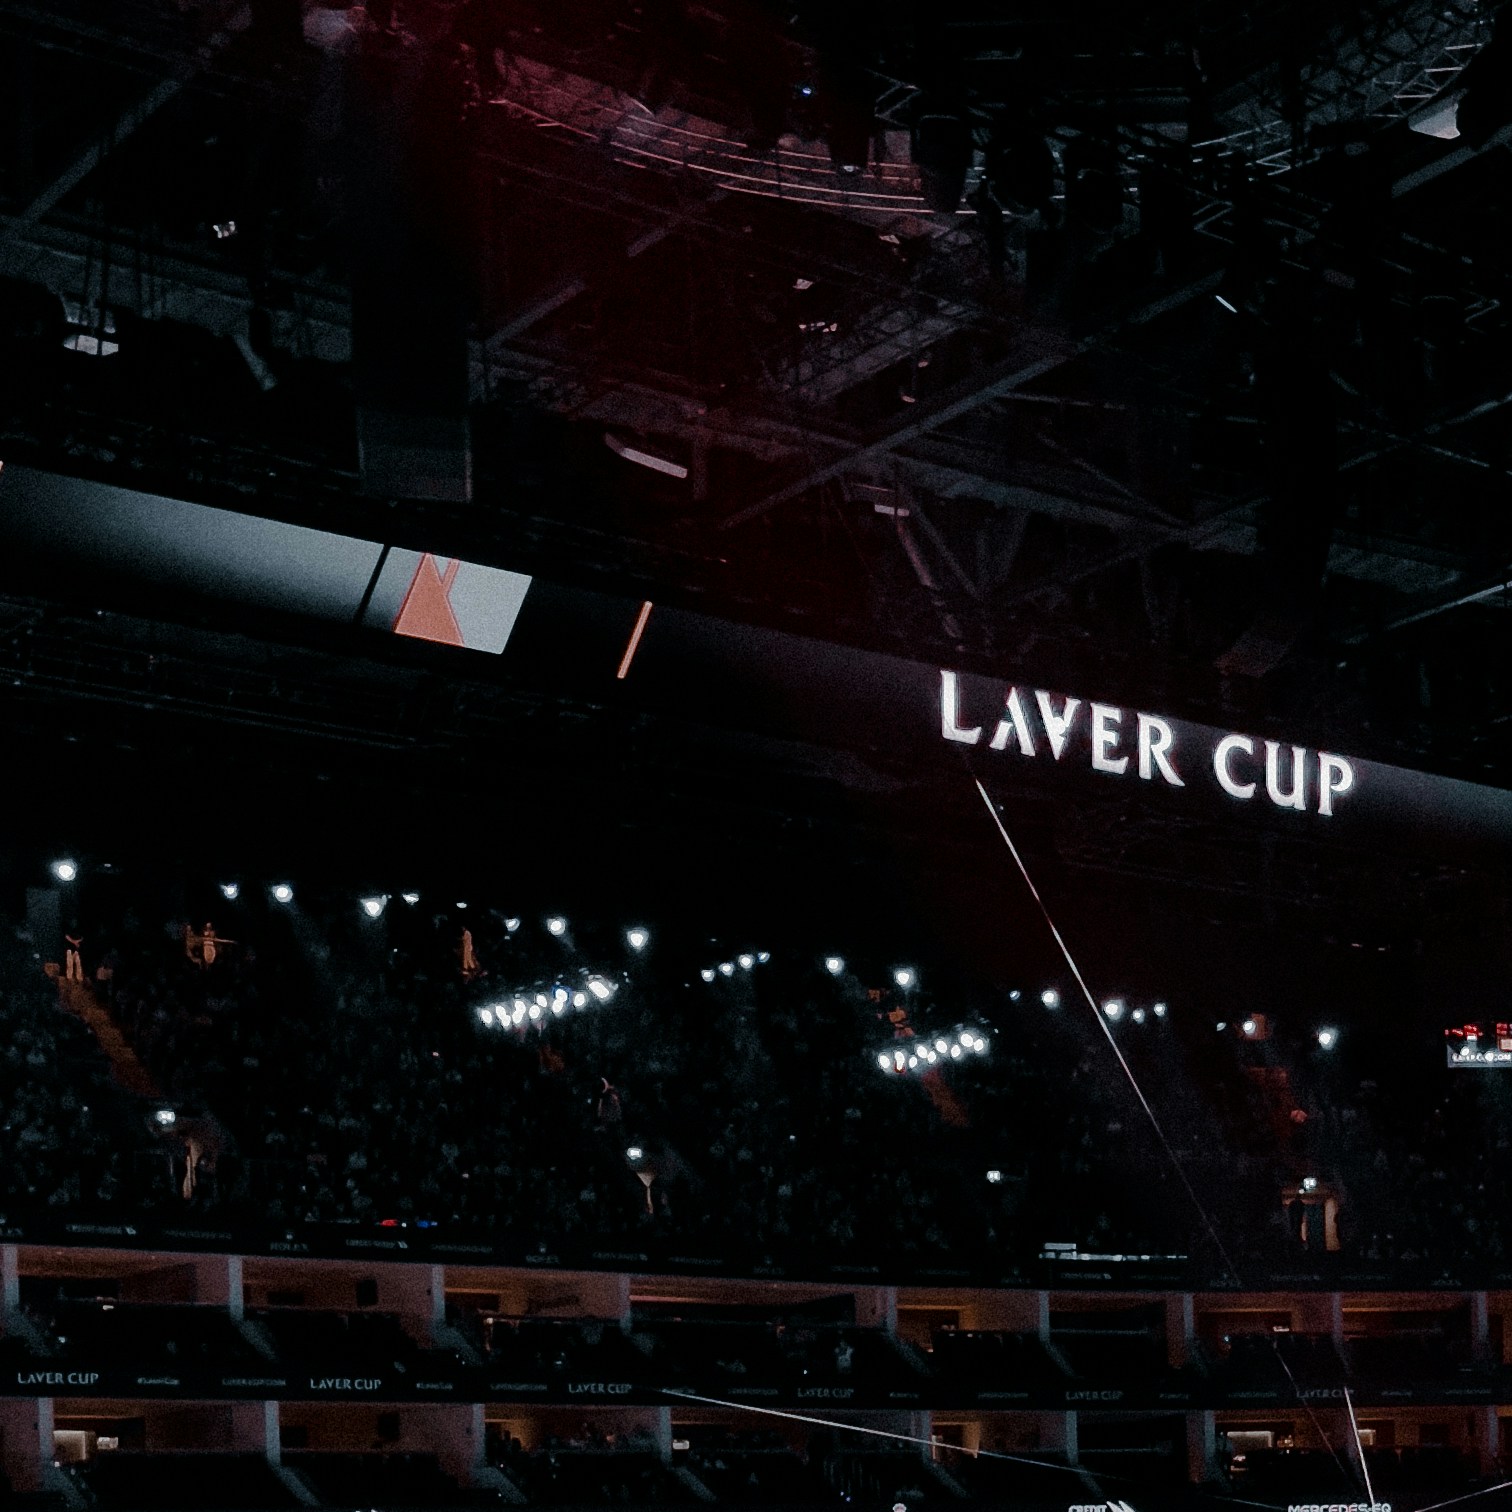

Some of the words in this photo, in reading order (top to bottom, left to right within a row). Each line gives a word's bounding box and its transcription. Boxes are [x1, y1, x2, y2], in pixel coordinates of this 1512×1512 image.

[940, 669, 1185, 787] LAVER
[1213, 733, 1357, 816] CUP
[16, 1371, 64, 1385] LAVER
[66, 1371, 99, 1385] CUP
[309, 1378, 351, 1391] LAVER
[354, 1377, 382, 1390] CUP
[567, 1383, 606, 1395] LAVER
[607, 1383, 633, 1395] CUP
